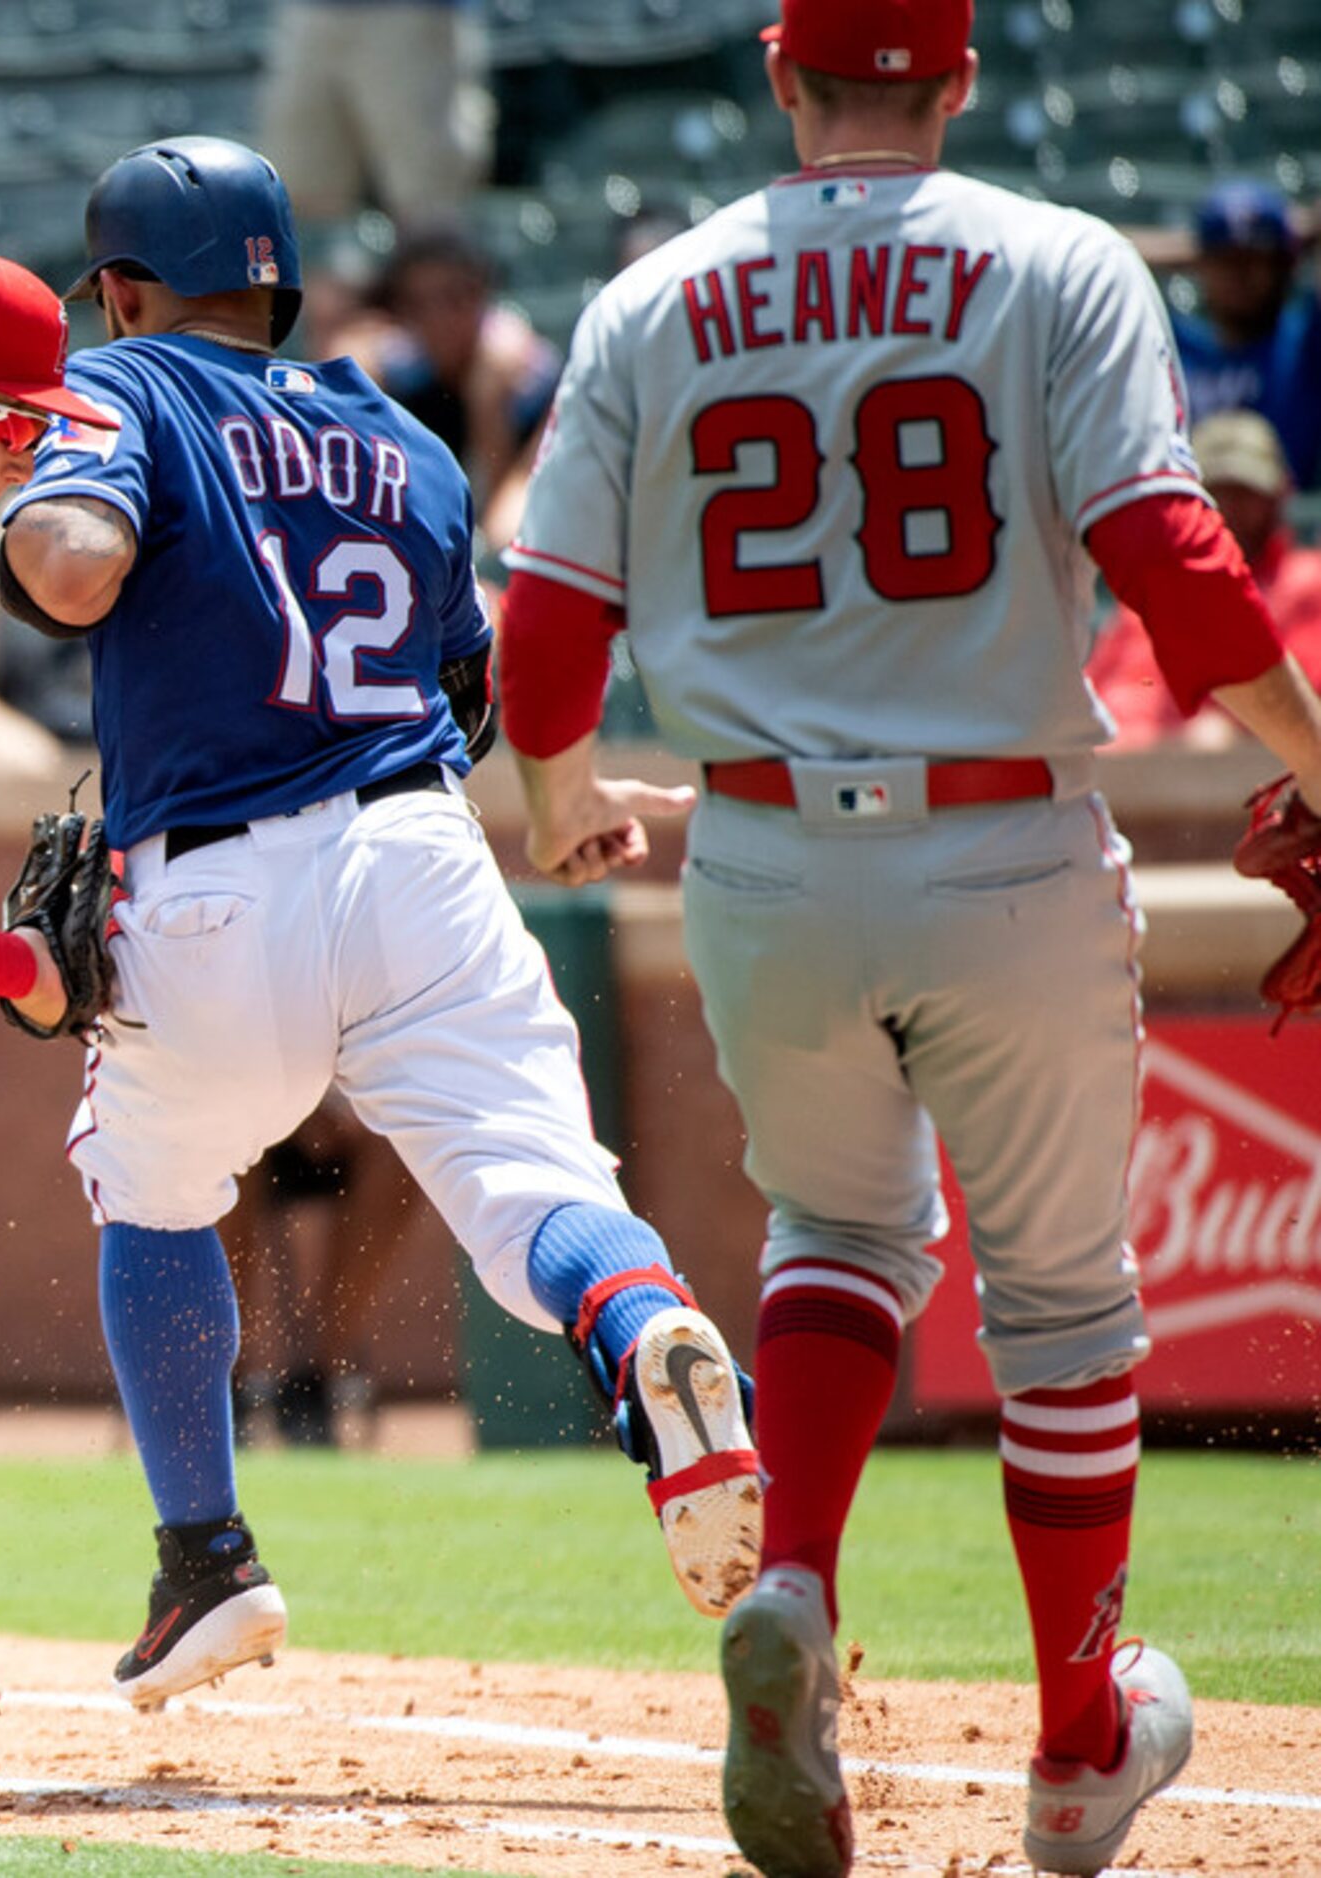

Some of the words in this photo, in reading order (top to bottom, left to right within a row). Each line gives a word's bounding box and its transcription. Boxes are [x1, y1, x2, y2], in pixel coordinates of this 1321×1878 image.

[245, 236, 274, 265] 12
[681, 244, 994, 364] HEANEY
[219, 415, 408, 526] ODOR
[690, 374, 1005, 619] 28
[257, 528, 429, 721] 12
